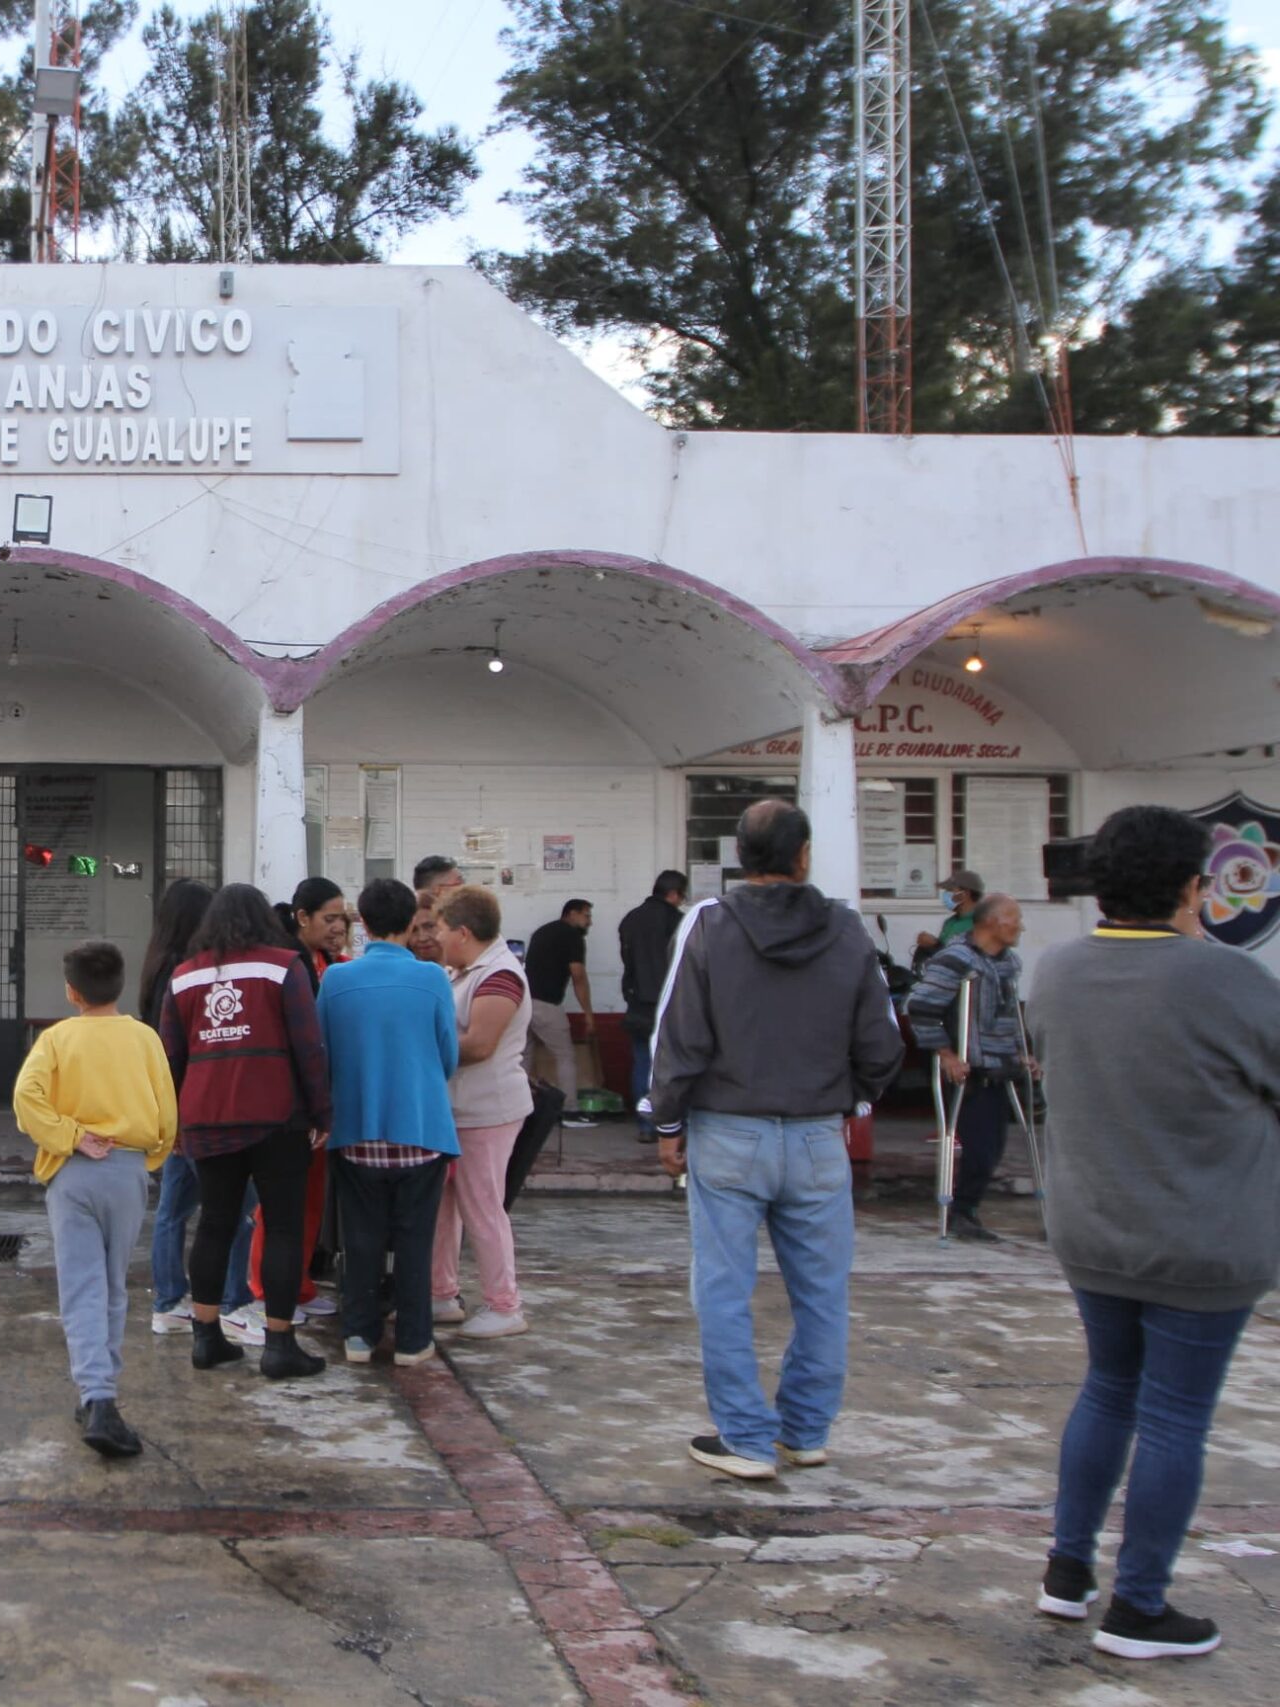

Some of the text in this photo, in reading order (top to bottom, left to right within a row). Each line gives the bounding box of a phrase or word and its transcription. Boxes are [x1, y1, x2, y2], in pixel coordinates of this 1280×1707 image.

[48, 416, 253, 465] GUADALUPE
[912, 669, 1004, 727] CIUDADANA
[877, 742, 894, 757] DE
[895, 742, 975, 758] GUADALUPE
[199, 1024, 251, 1041] ECATEPEC
